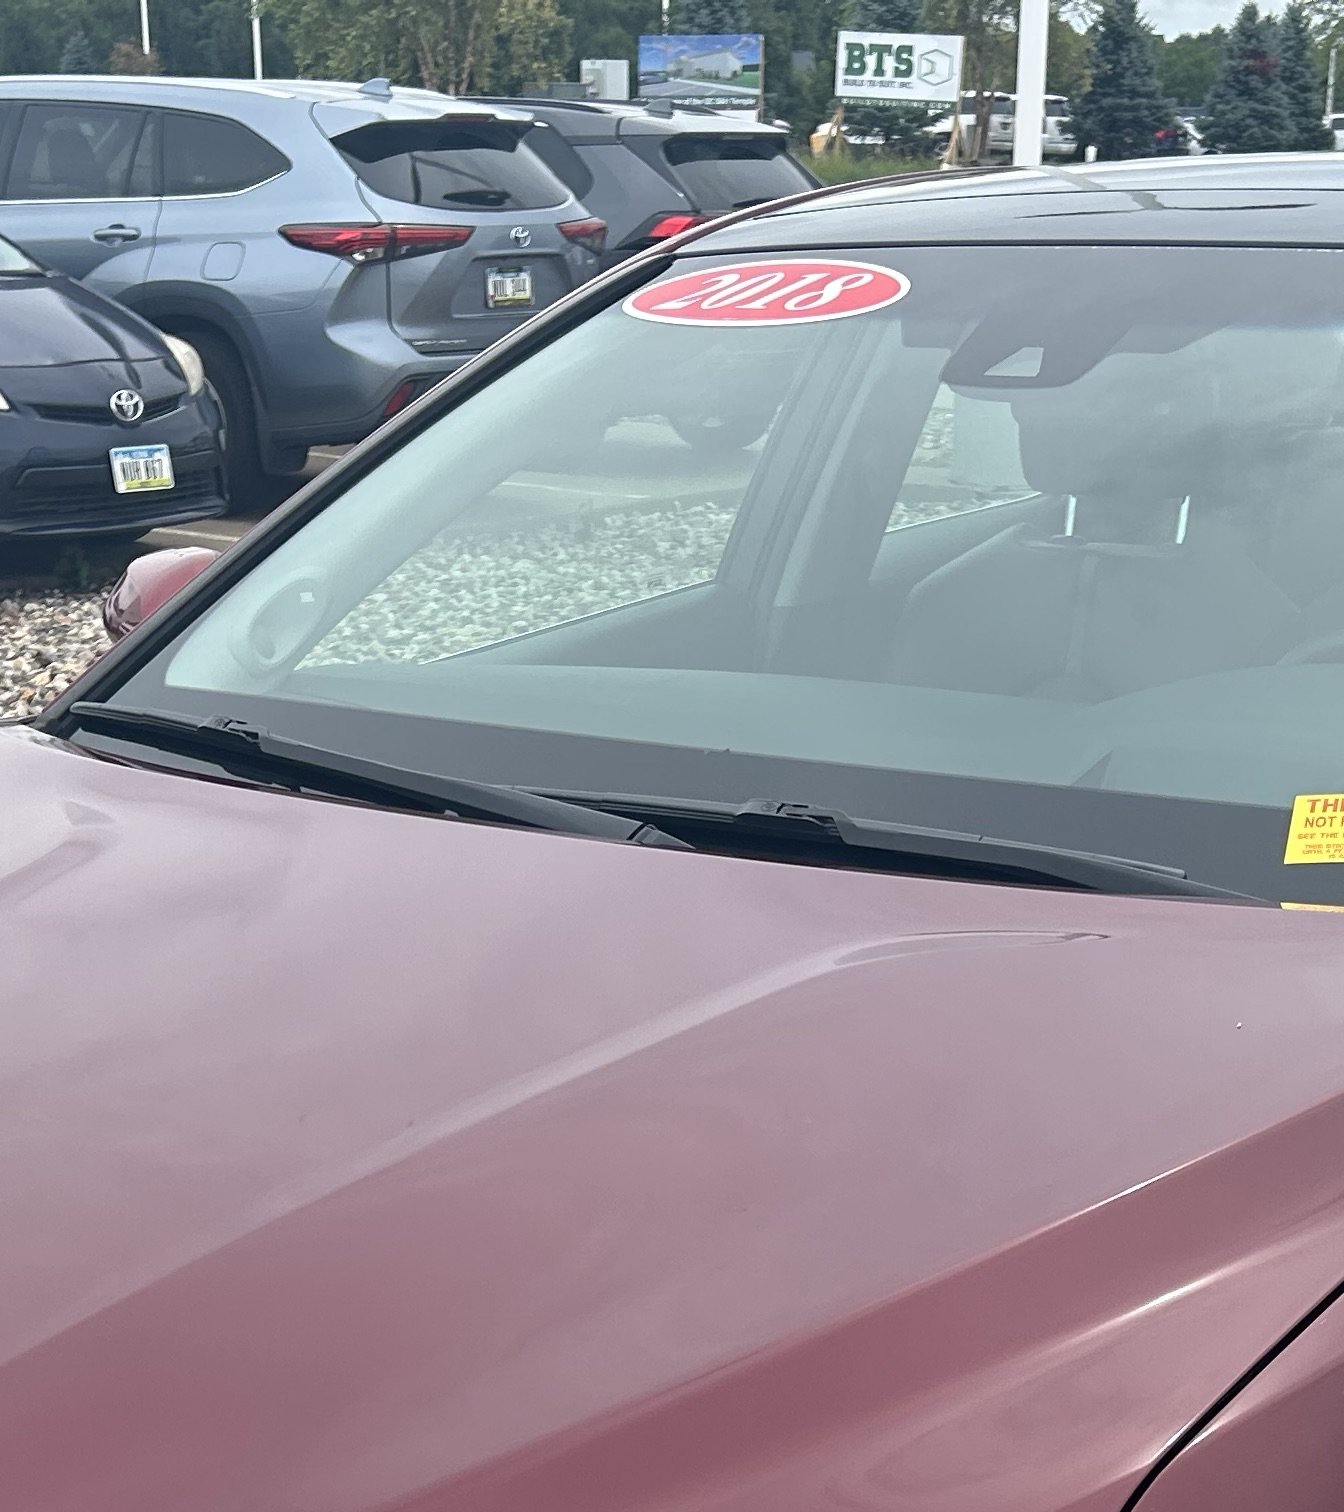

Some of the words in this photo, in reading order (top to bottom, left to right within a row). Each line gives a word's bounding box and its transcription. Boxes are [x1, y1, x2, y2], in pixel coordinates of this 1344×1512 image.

[844, 43, 913, 78] BTS
[649, 271, 874, 311] 2018
[1304, 816, 1337, 829] NOT
